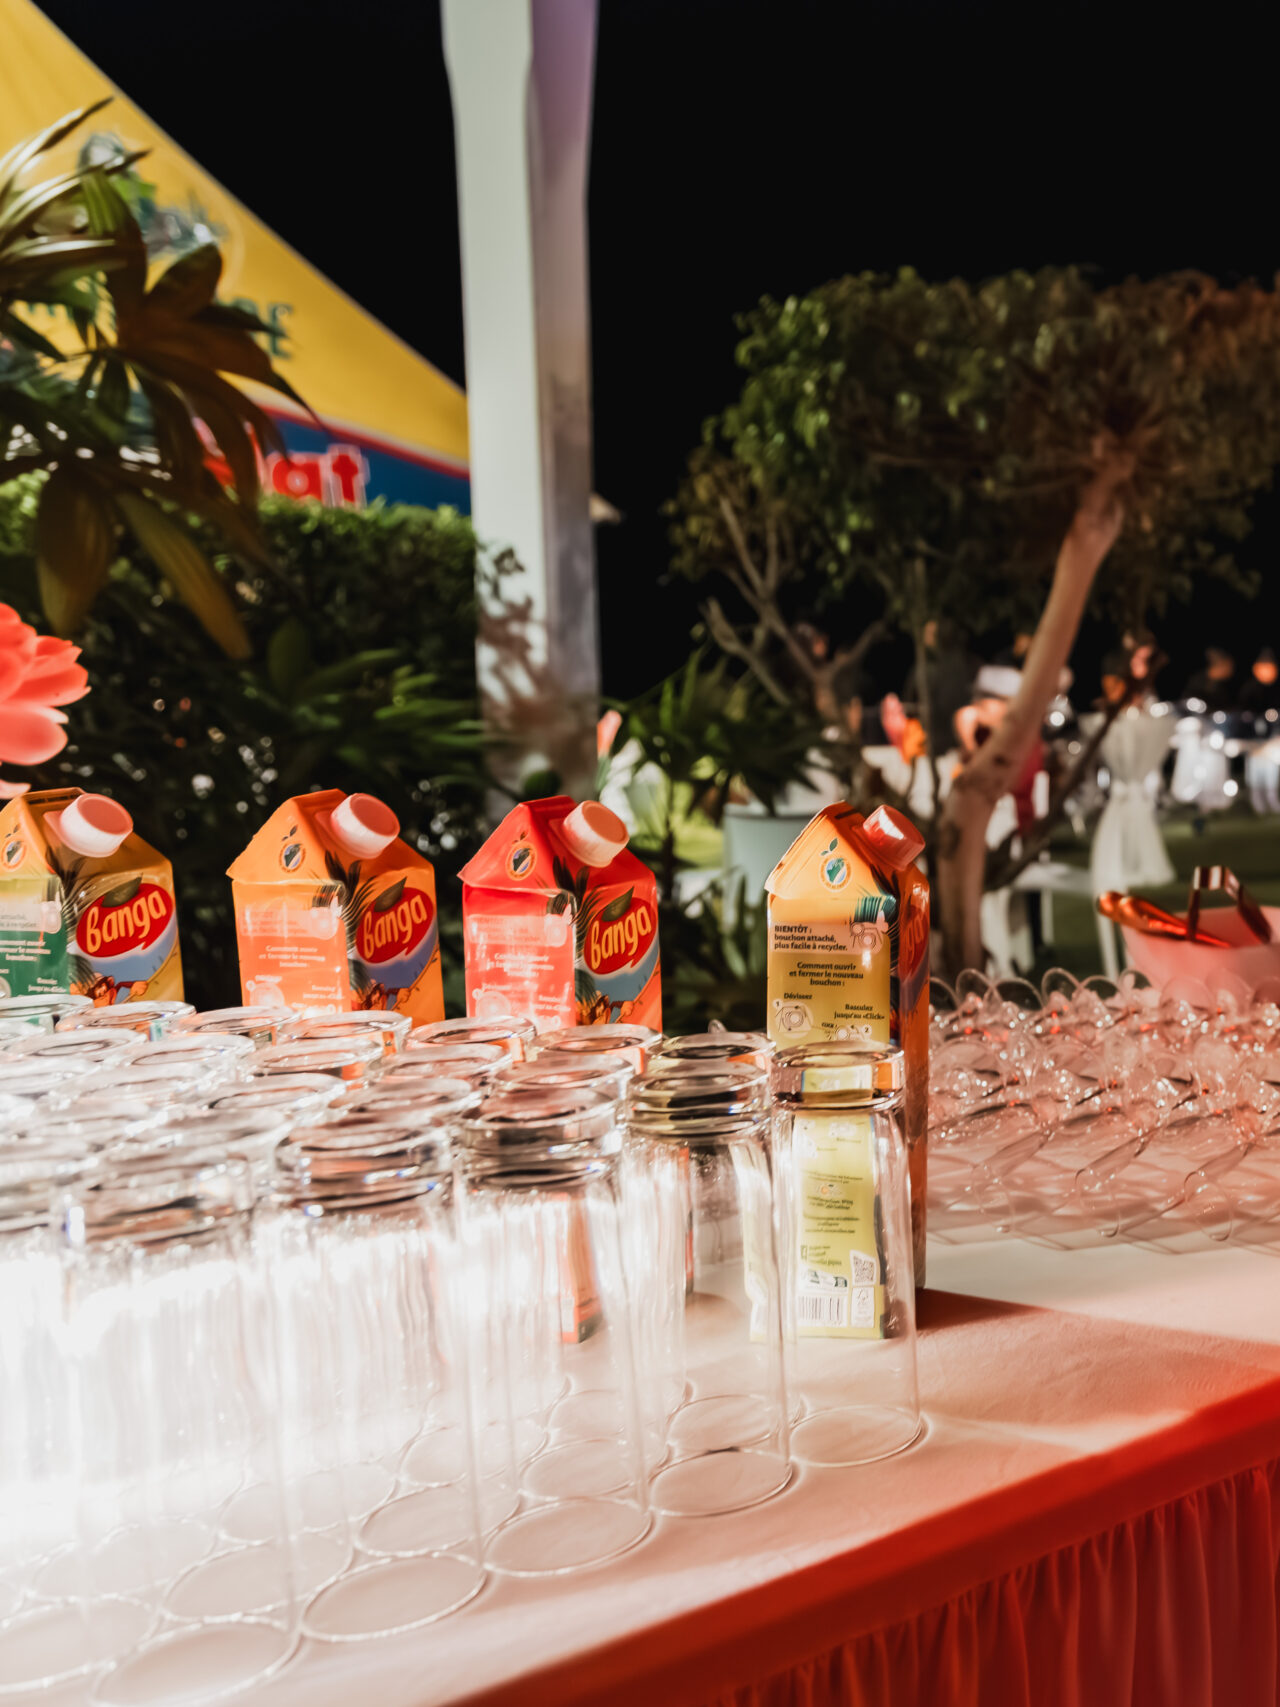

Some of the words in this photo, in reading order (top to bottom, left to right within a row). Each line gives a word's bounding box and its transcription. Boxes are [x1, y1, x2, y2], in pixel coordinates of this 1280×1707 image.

[774, 924, 808, 934] BIENTÔT
[807, 935, 836, 943] attaché,
[818, 943, 848, 952] recycler.
[797, 962, 833, 970] Comment
[834, 962, 856, 970] ouvrir
[798, 970, 824, 978] fermer
[810, 978, 842, 986] bouchon
